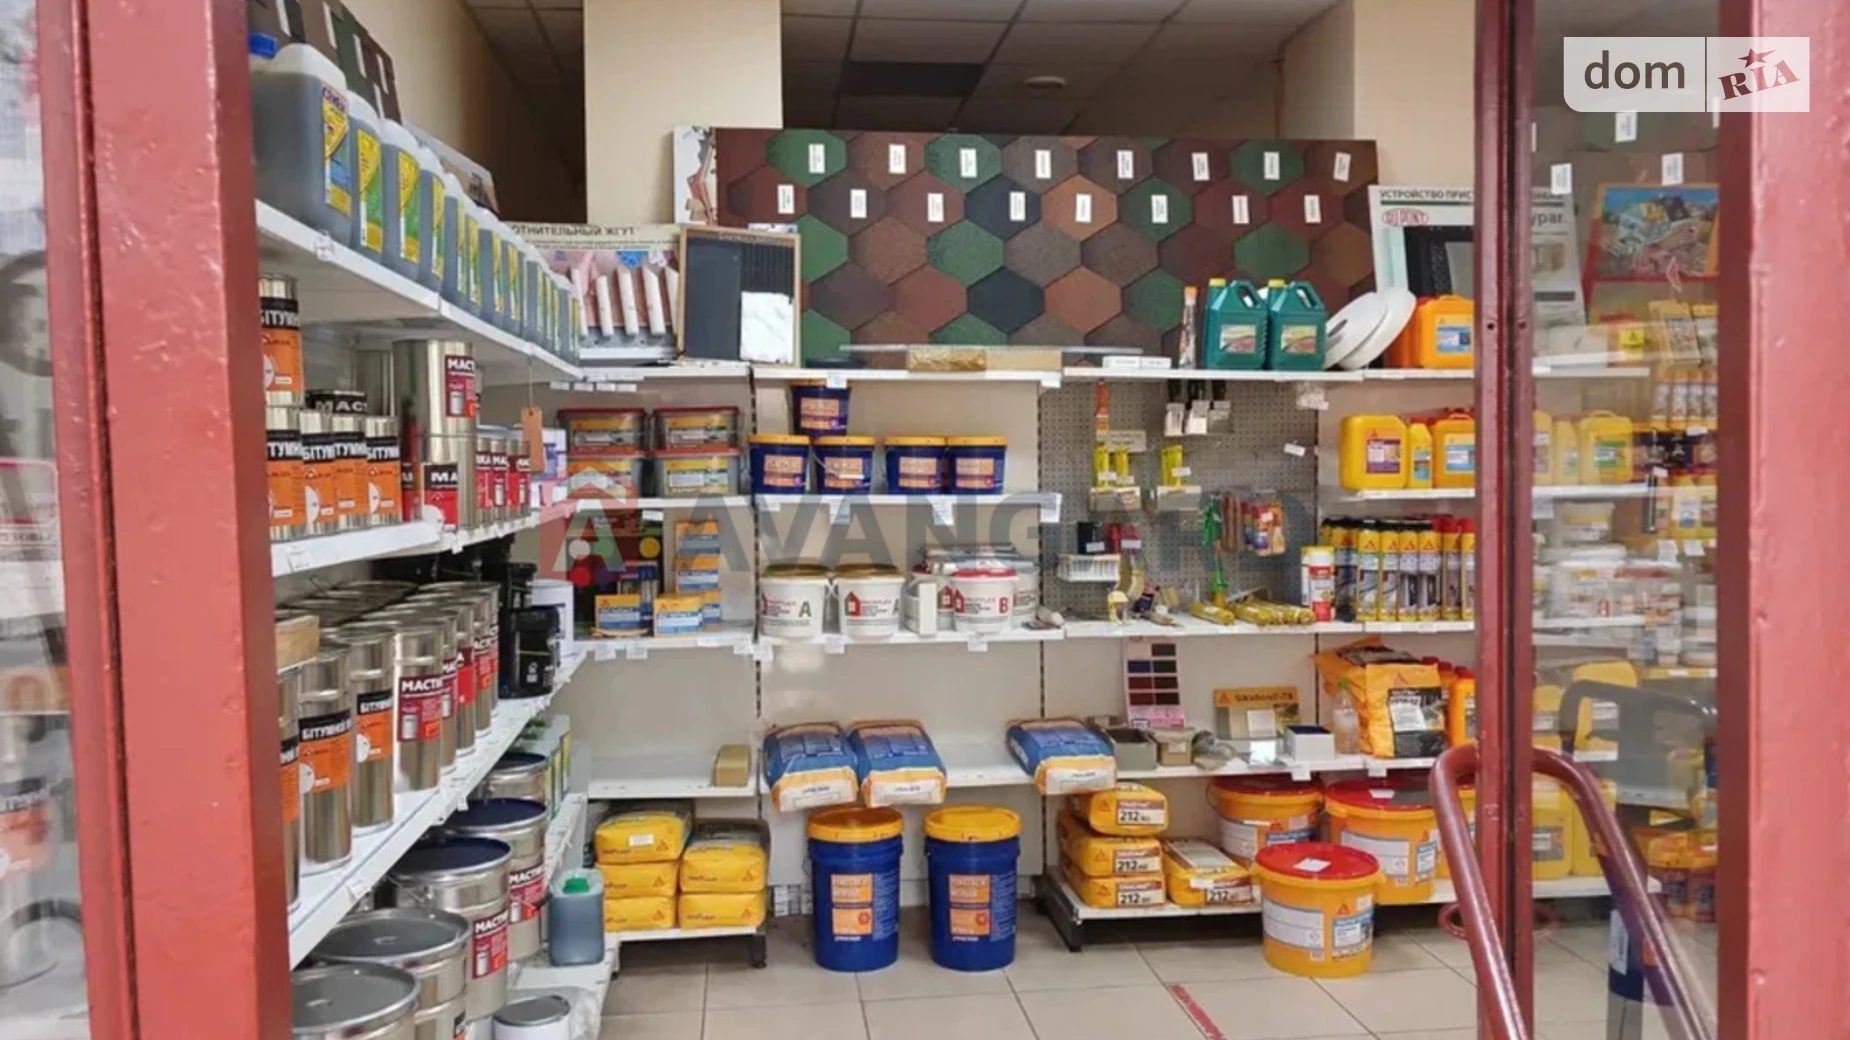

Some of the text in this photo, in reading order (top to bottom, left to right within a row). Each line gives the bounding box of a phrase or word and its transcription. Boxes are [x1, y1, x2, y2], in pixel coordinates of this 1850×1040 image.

[1380, 189, 1444, 199] УСТРОЙСТВО
[605, 226, 635, 236] ЖГУТ
[998, 596, 1009, 614] B
[1120, 811, 1140, 822] 212
[1117, 861, 1137, 871] 212
[1120, 892, 1141, 904] 212
[1209, 891, 1229, 901] 212
